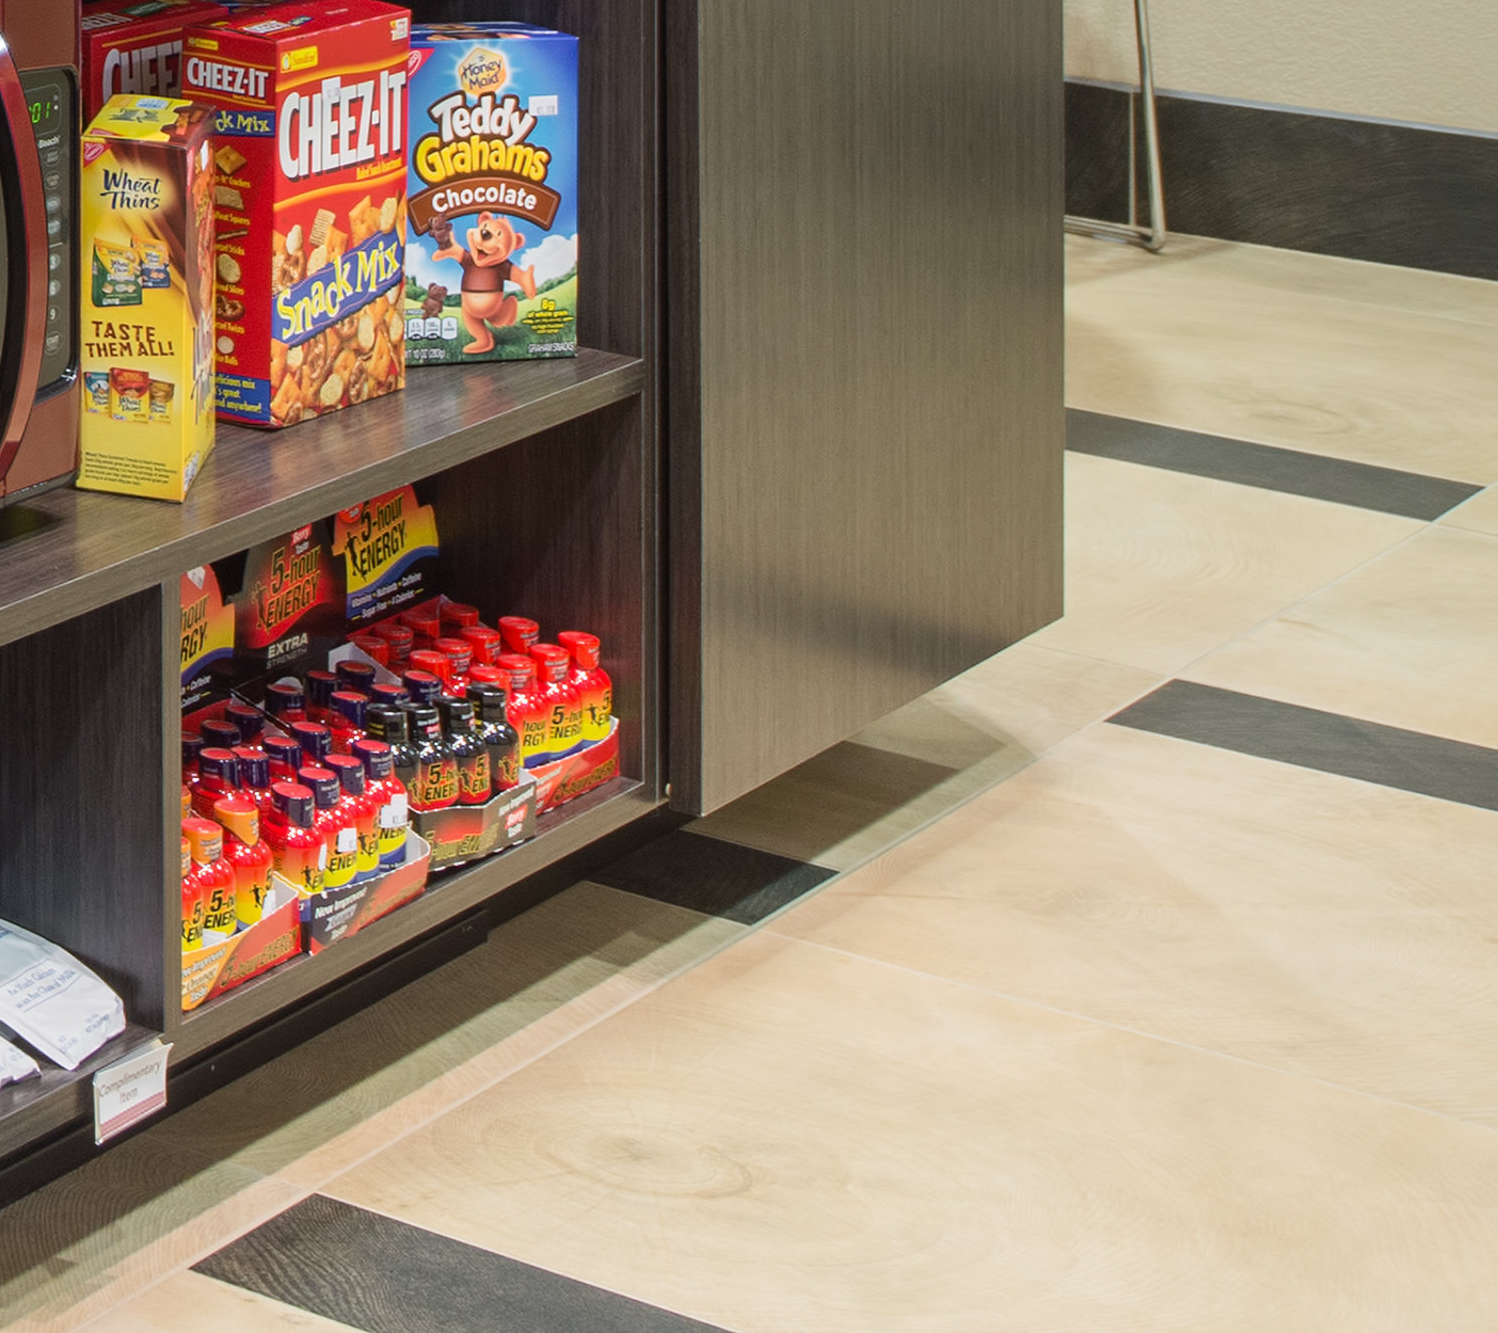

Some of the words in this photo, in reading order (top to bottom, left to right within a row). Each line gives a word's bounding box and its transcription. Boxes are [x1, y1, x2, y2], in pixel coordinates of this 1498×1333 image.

[187, 54, 270, 100] CHEEZ-IT
[469, 72, 501, 91] Maid
[278, 71, 406, 180] CHEEZ-IT
[430, 95, 535, 145] Teddy
[415, 136, 550, 181] Grahams
[101, 168, 162, 195] Wheat
[109, 188, 160, 212] Thins
[431, 184, 538, 212] Chocolate
[276, 257, 354, 341] Snack
[91, 319, 156, 344] TASTE
[85, 340, 130, 359] THEM
[131, 340, 175, 358] ALL!
[267, 633, 308, 659] EXTRA
[100, 1057, 162, 1096] Complimentary
